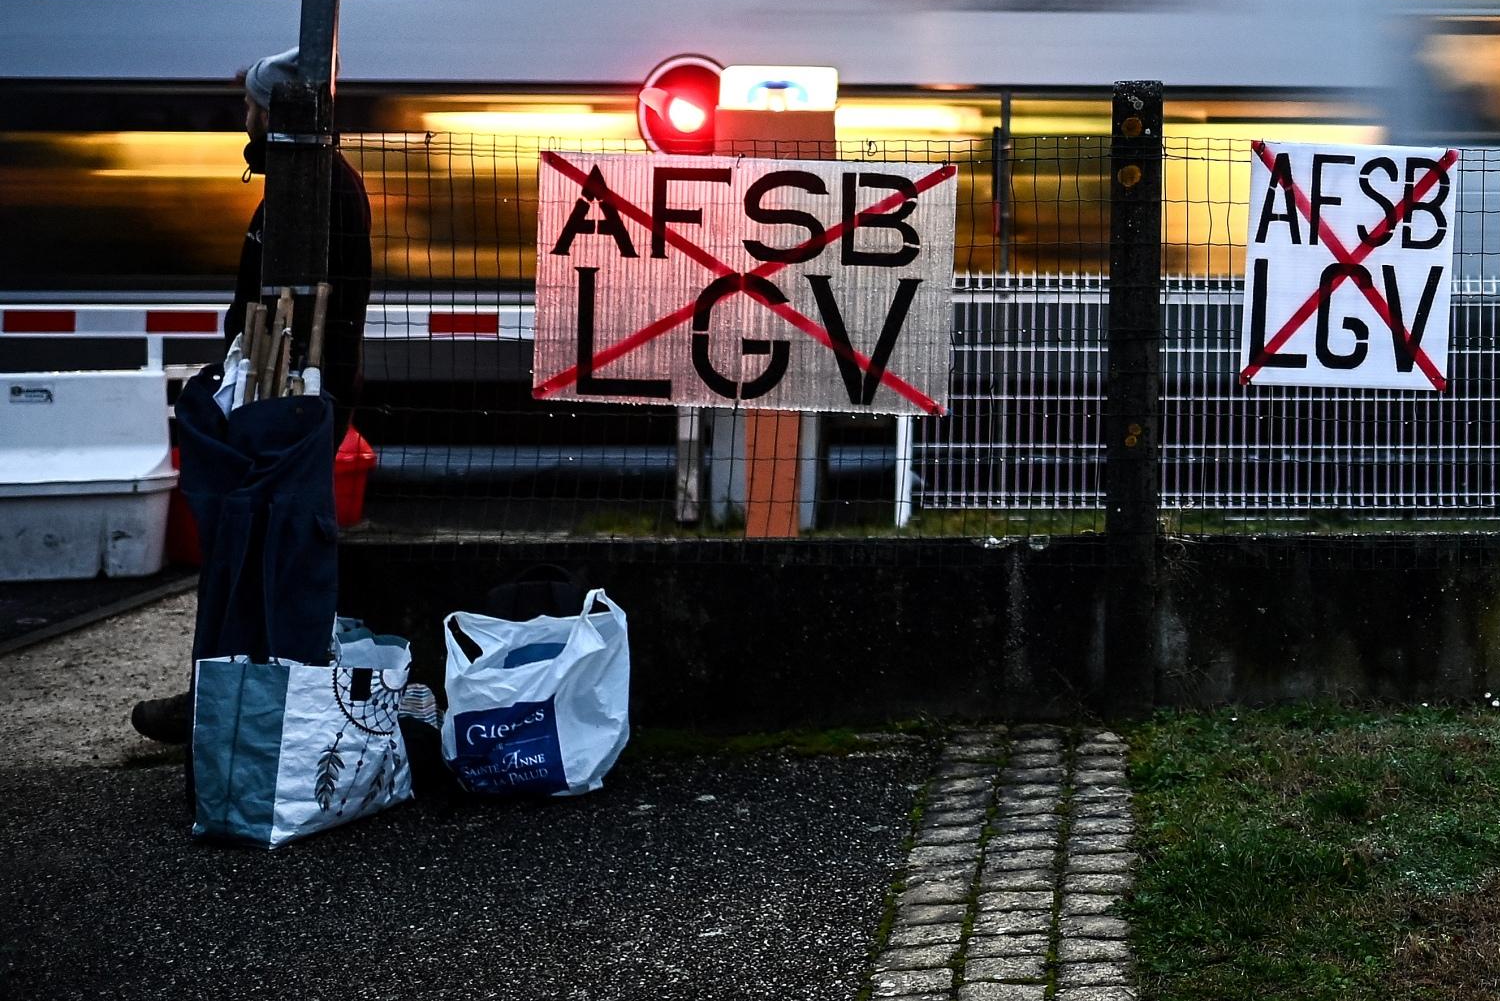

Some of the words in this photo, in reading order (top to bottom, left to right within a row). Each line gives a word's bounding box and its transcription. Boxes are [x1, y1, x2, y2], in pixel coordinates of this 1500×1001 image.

[550, 164, 921, 267] AFSB
[1255, 152, 1450, 250] AFSB
[574, 266, 924, 406] LGV
[1248, 258, 1444, 373] LGV
